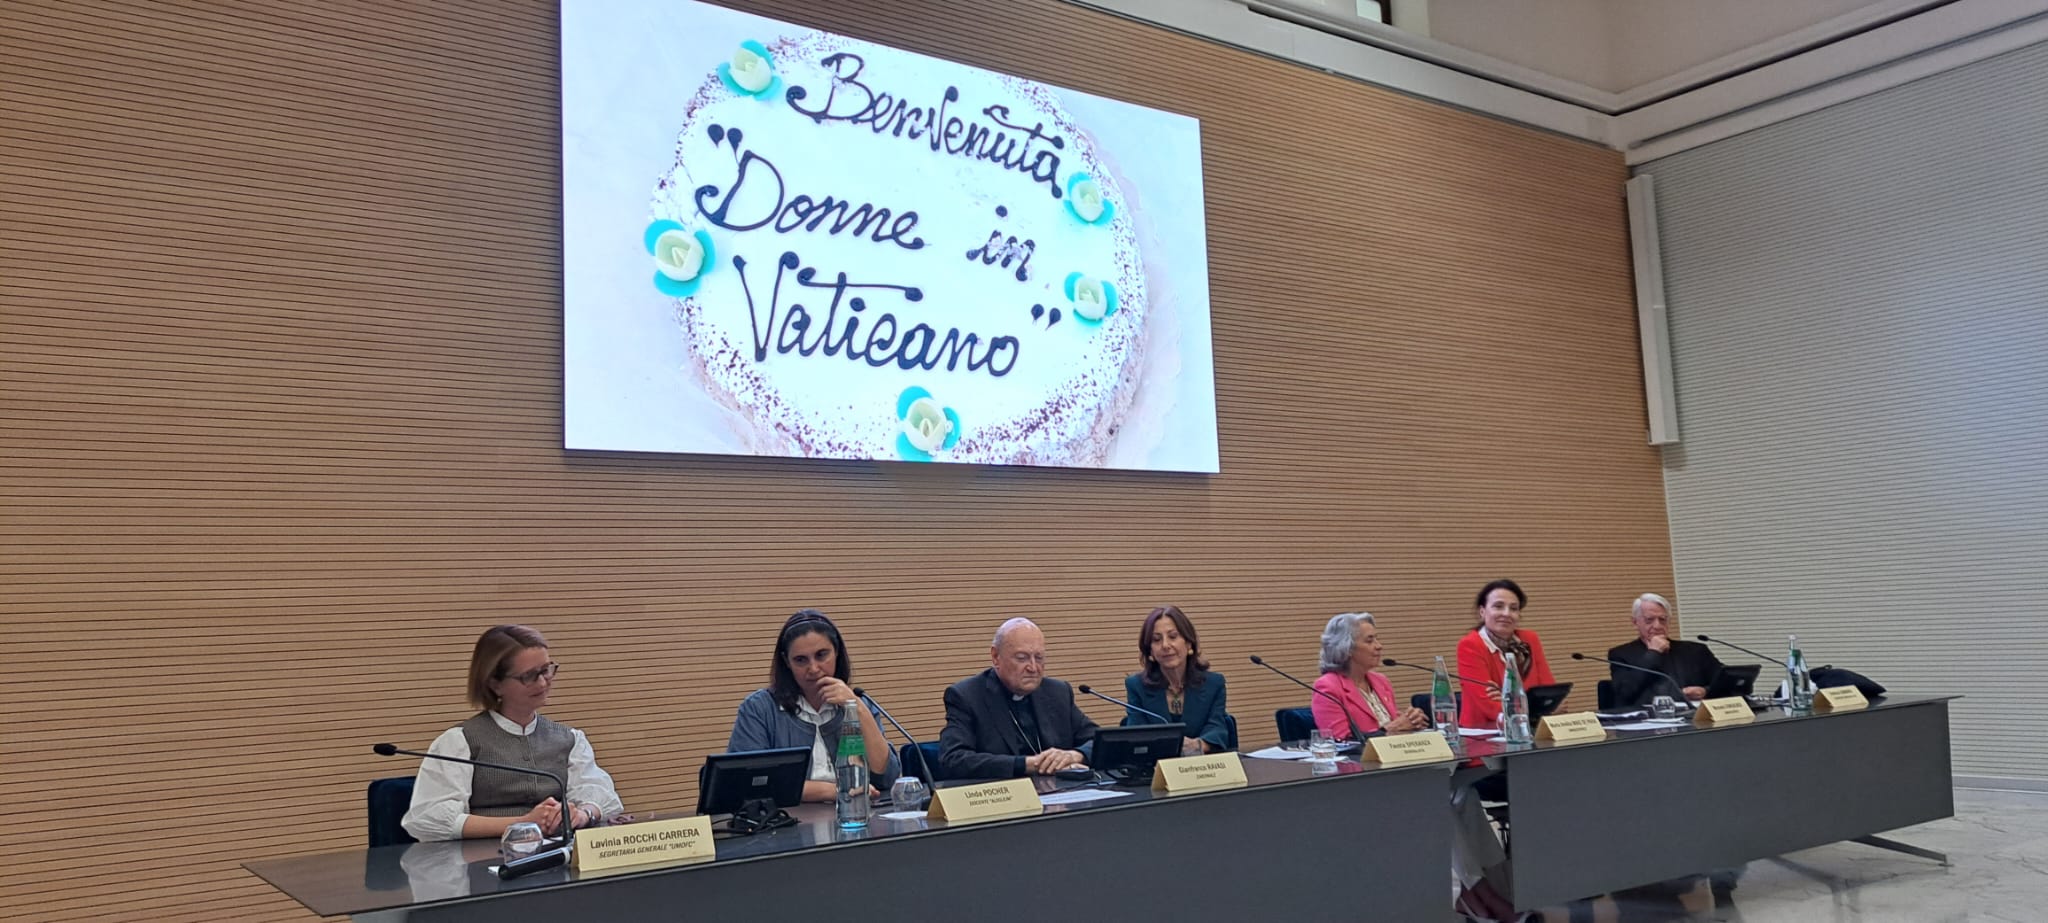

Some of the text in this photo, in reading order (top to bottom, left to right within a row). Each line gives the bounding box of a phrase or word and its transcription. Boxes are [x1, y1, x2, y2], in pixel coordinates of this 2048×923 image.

[695, 124, 1036, 281] "Donne in
[964, 786, 1010, 799] Linda POCHER
[590, 828, 700, 849] Lavinia ROCCHI CARRERA
[599, 848, 636, 858] SEGRETARIA
[637, 844, 667, 853] GENERALE
